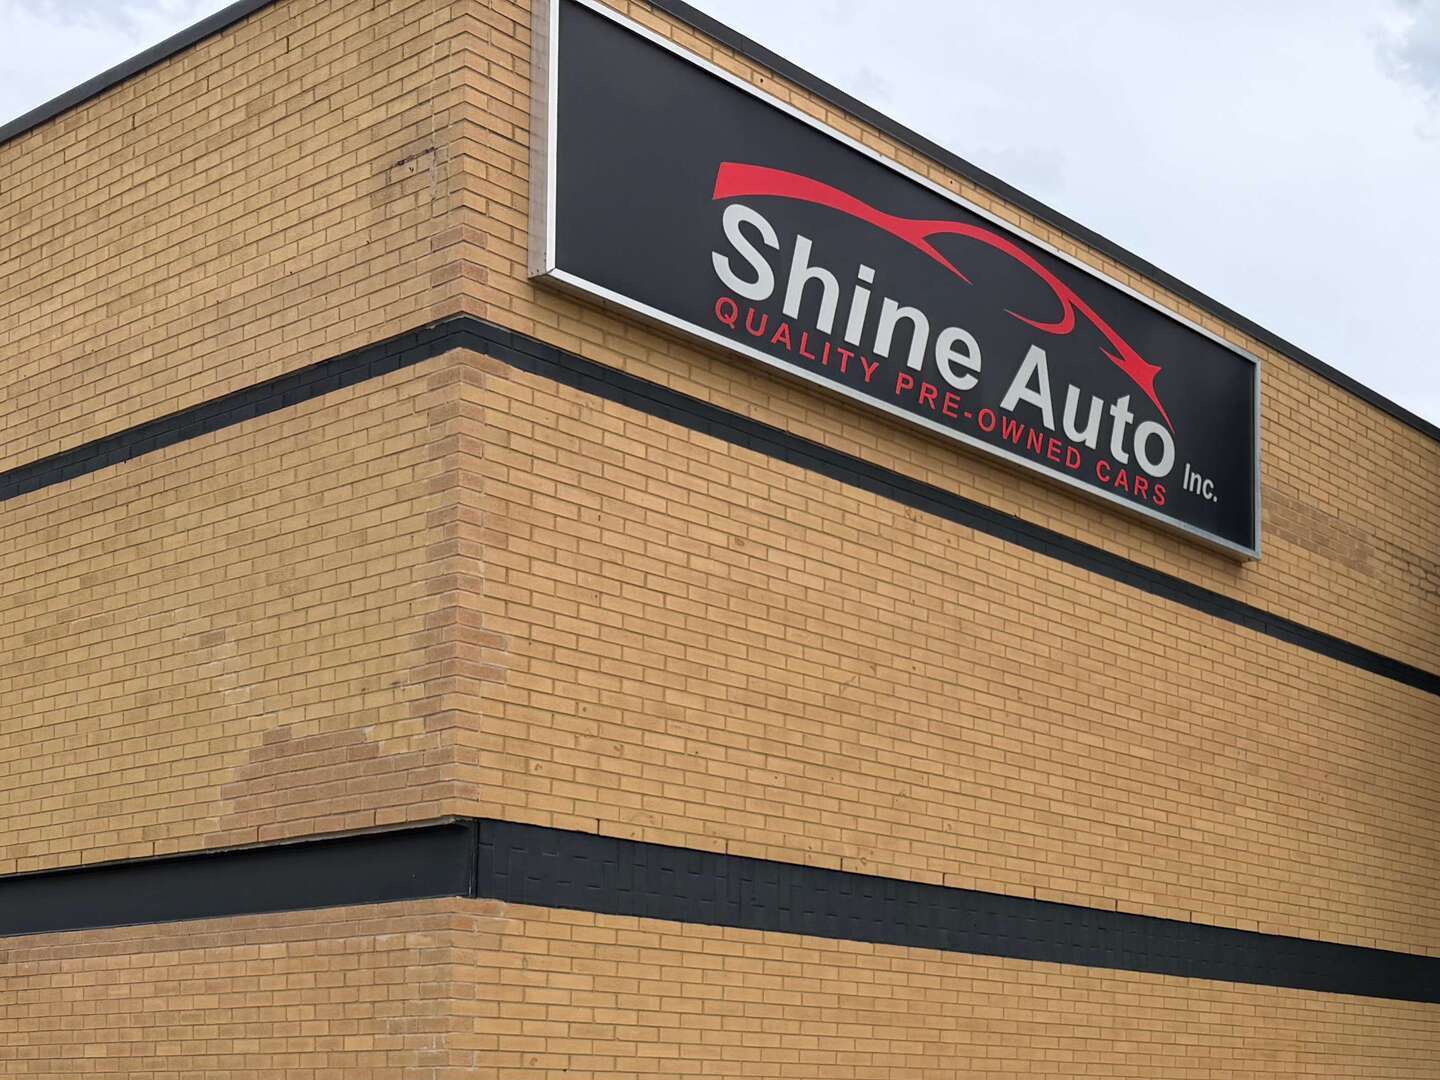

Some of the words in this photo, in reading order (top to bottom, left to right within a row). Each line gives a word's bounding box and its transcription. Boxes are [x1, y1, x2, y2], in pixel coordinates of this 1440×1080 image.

[712, 204, 982, 391] Shine
[1000, 344, 1176, 477] Auto
[1183, 463, 1218, 502] Inc.
[715, 297, 879, 383] QUALITY
[895, 372, 1081, 470] PRE-OWNED
[1096, 460, 1167, 506] CARS
